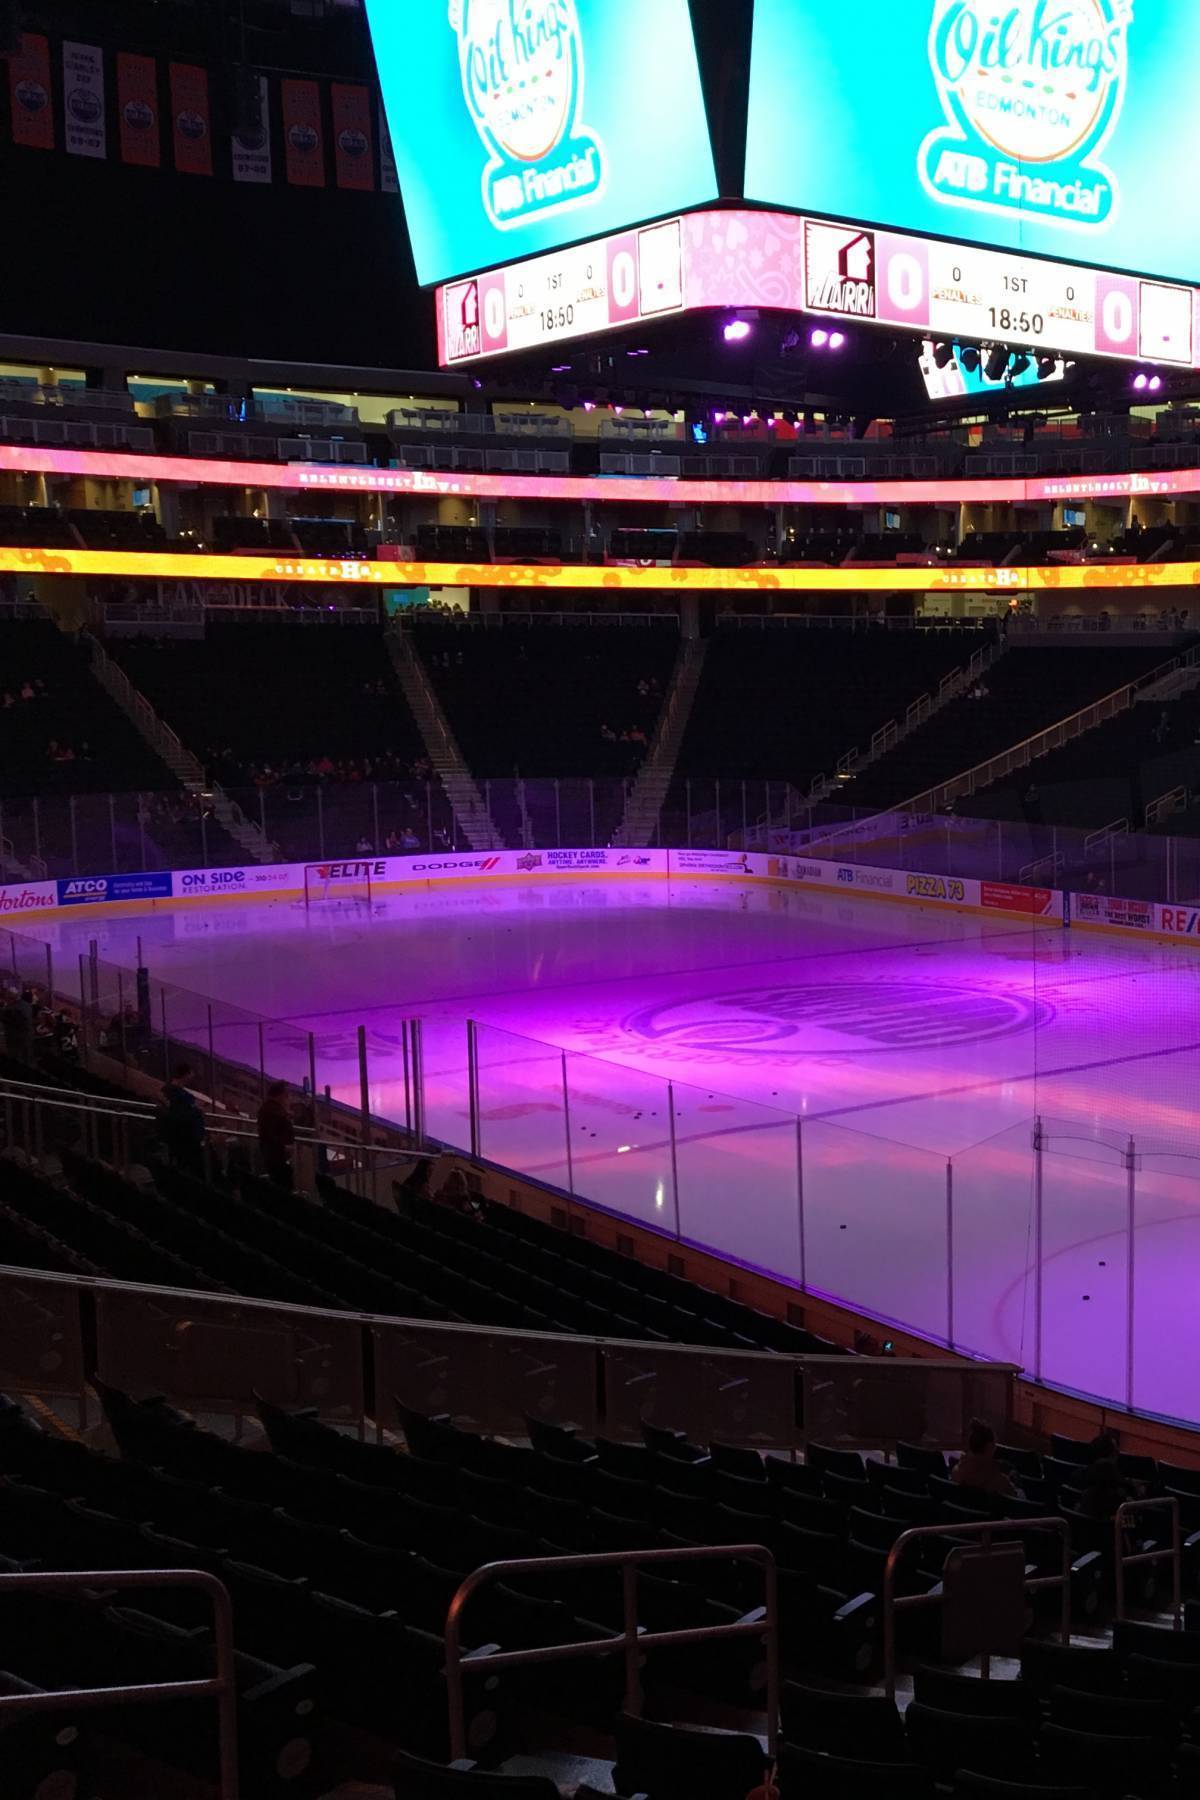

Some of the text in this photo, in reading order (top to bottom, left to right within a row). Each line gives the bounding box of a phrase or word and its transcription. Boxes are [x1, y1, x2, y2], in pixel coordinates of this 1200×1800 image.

[935, 0, 1121, 93] Oil Kings
[466, 19, 508, 94] Oil
[975, 90, 1071, 129] EDMONTON
[523, 147, 595, 204] Financial
[934, 149, 1108, 216] ATB Financial
[547, 273, 564, 291] 1ST
[887, 253, 923, 311] 0
[952, 266, 962, 282] 0
[1003, 275, 1029, 294] 1ST
[1065, 286, 1075, 302] 0
[931, 287, 984, 305] PENALTIES
[540, 304, 575, 331] 18:50
[988, 305, 1044, 335] 18:50
[1047, 304, 1093, 323] PENALTIES
[1103, 289, 1133, 343] 0
[299, 473, 412, 489] RELENTLESSLY
[1044, 480, 1129, 494] RELENTLESSLY
[231, 585, 289, 608] DECK
[547, 851, 607, 859] HOCKEY CARDS.
[329, 861, 387, 879] ELITE
[413, 860, 485, 871] DODGE
[65, 879, 109, 894] ATCO
[182, 873, 205, 886] ON
[836, 868, 854, 882] ATB
[854, 870, 894, 888] Financial
[907, 874, 947, 899] PIZZA
[947, 879, 966, 901] 73
[182, 882, 245, 894] RESTORATION
[1127, 914, 1151, 924] WORST
